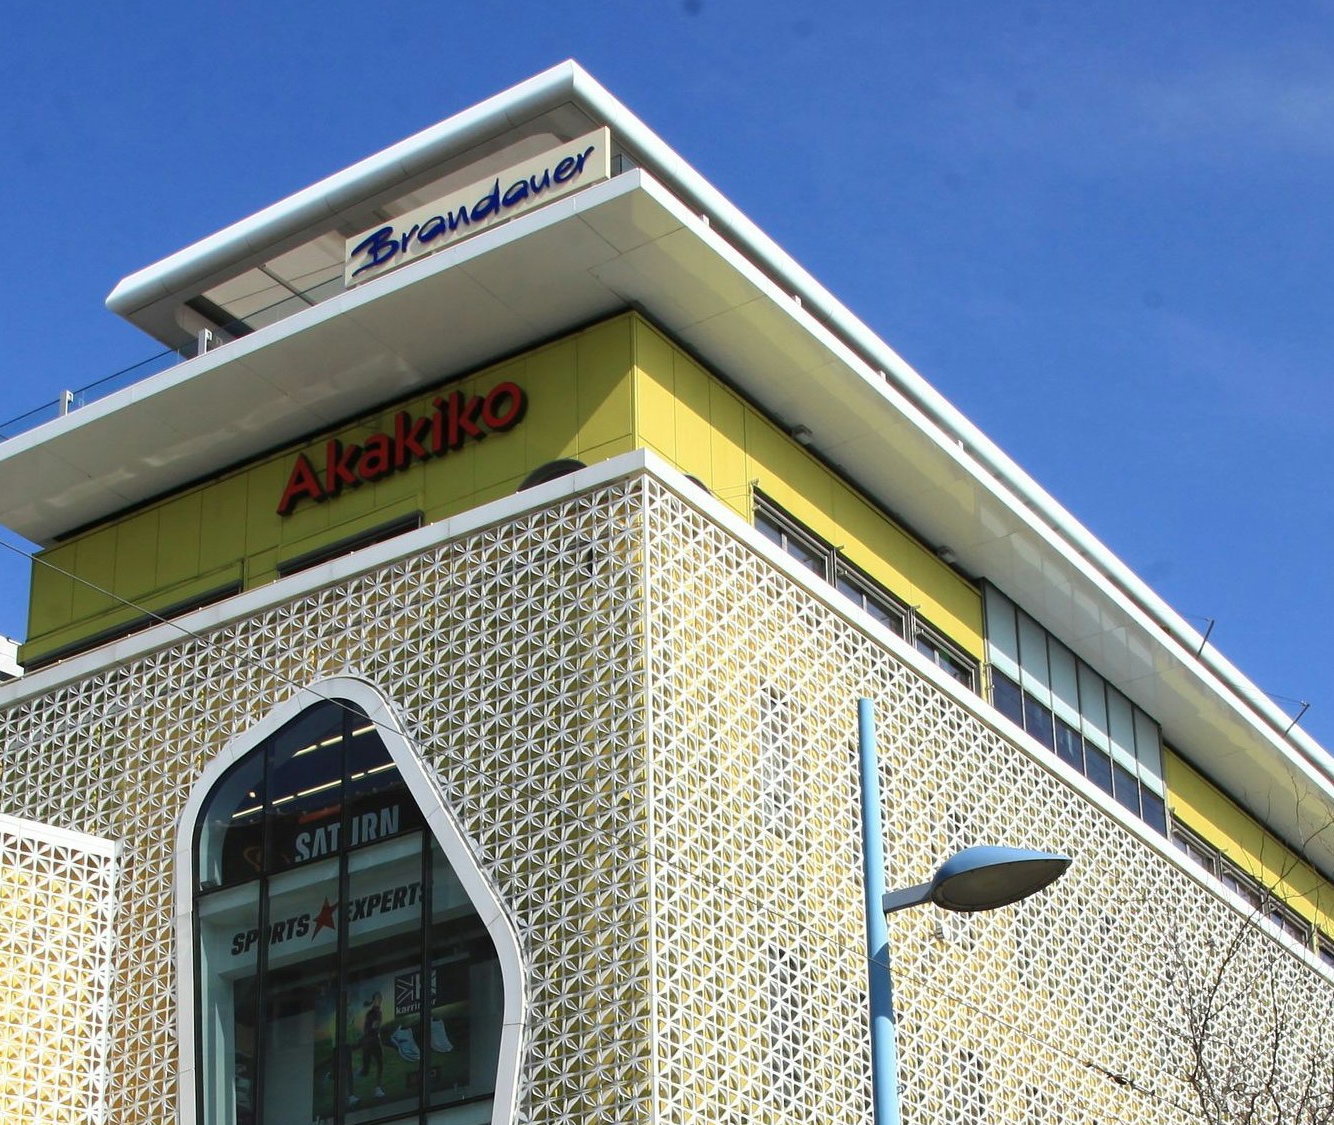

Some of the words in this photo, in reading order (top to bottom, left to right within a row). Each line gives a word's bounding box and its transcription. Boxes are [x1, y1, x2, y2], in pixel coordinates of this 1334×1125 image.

[351, 146, 595, 277] Brandauer
[276, 381, 526, 515] Akakiko
[231, 914, 310, 956] SPRTS
